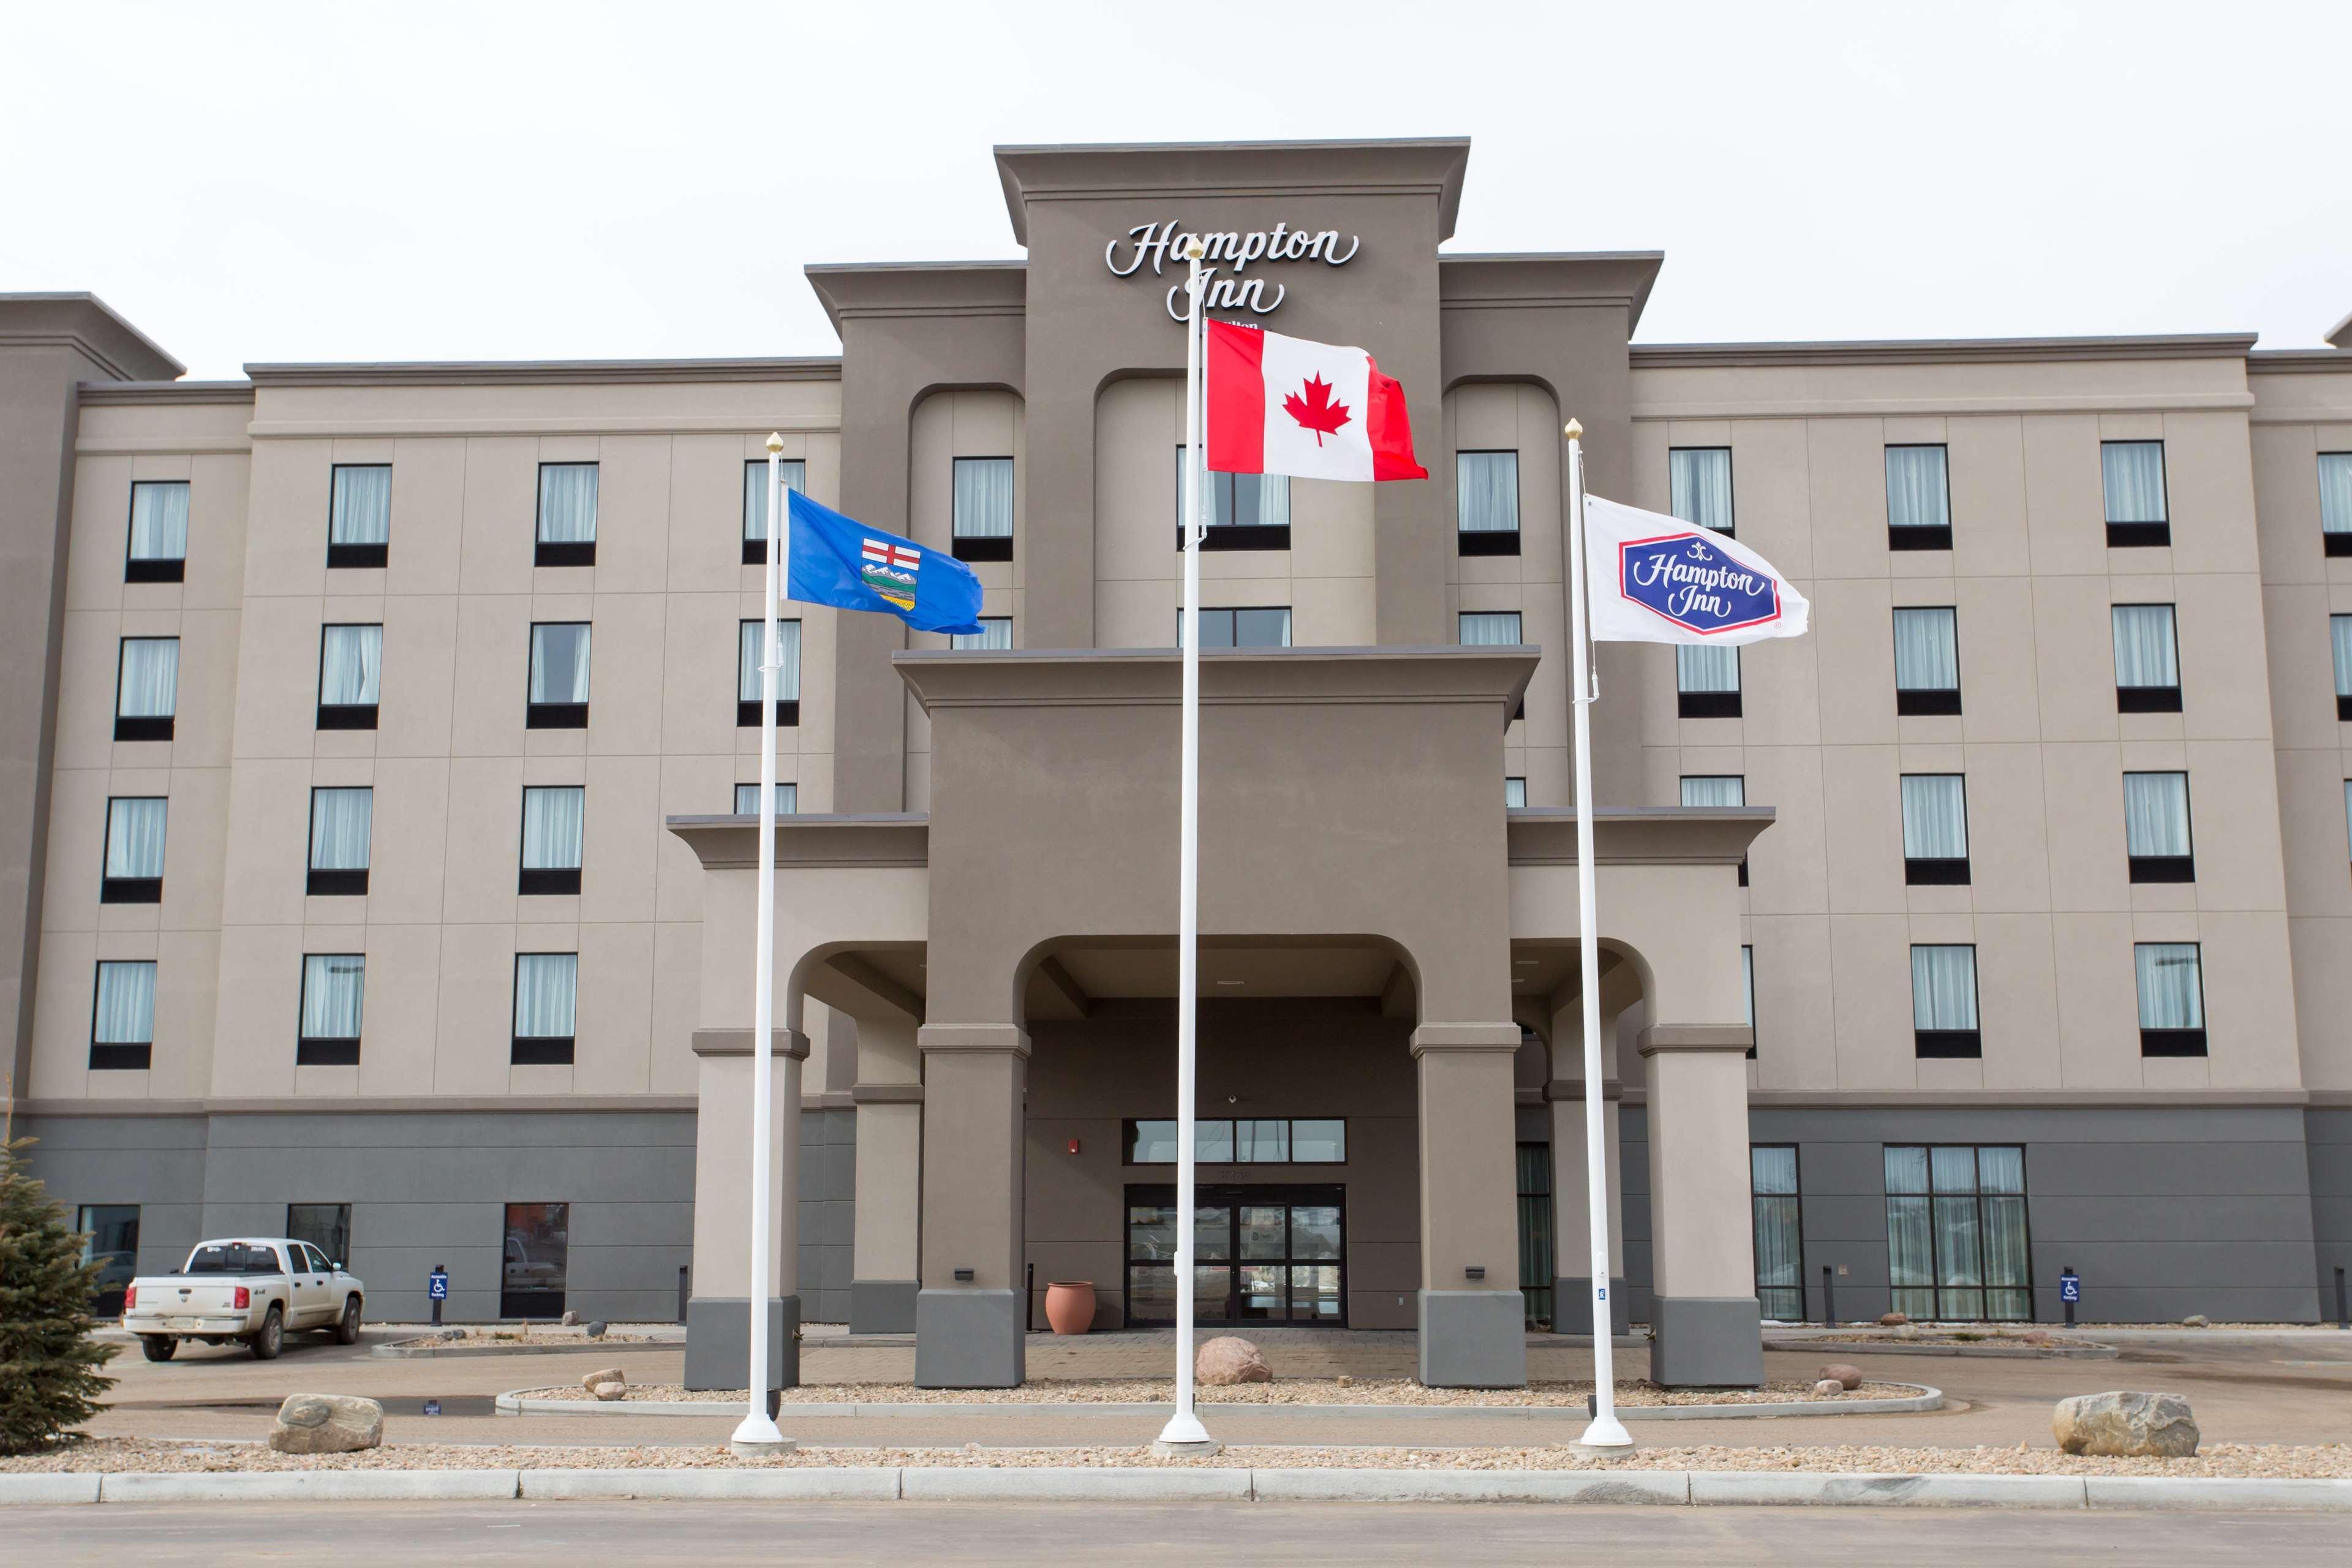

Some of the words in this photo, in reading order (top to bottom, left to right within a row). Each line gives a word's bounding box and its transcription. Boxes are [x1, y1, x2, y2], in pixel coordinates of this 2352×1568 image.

[1106, 220, 1359, 277] Hampton
[1166, 268, 1284, 322] Inn
[1634, 553, 1765, 597] Hampton
[1668, 586, 1732, 617] Inn
